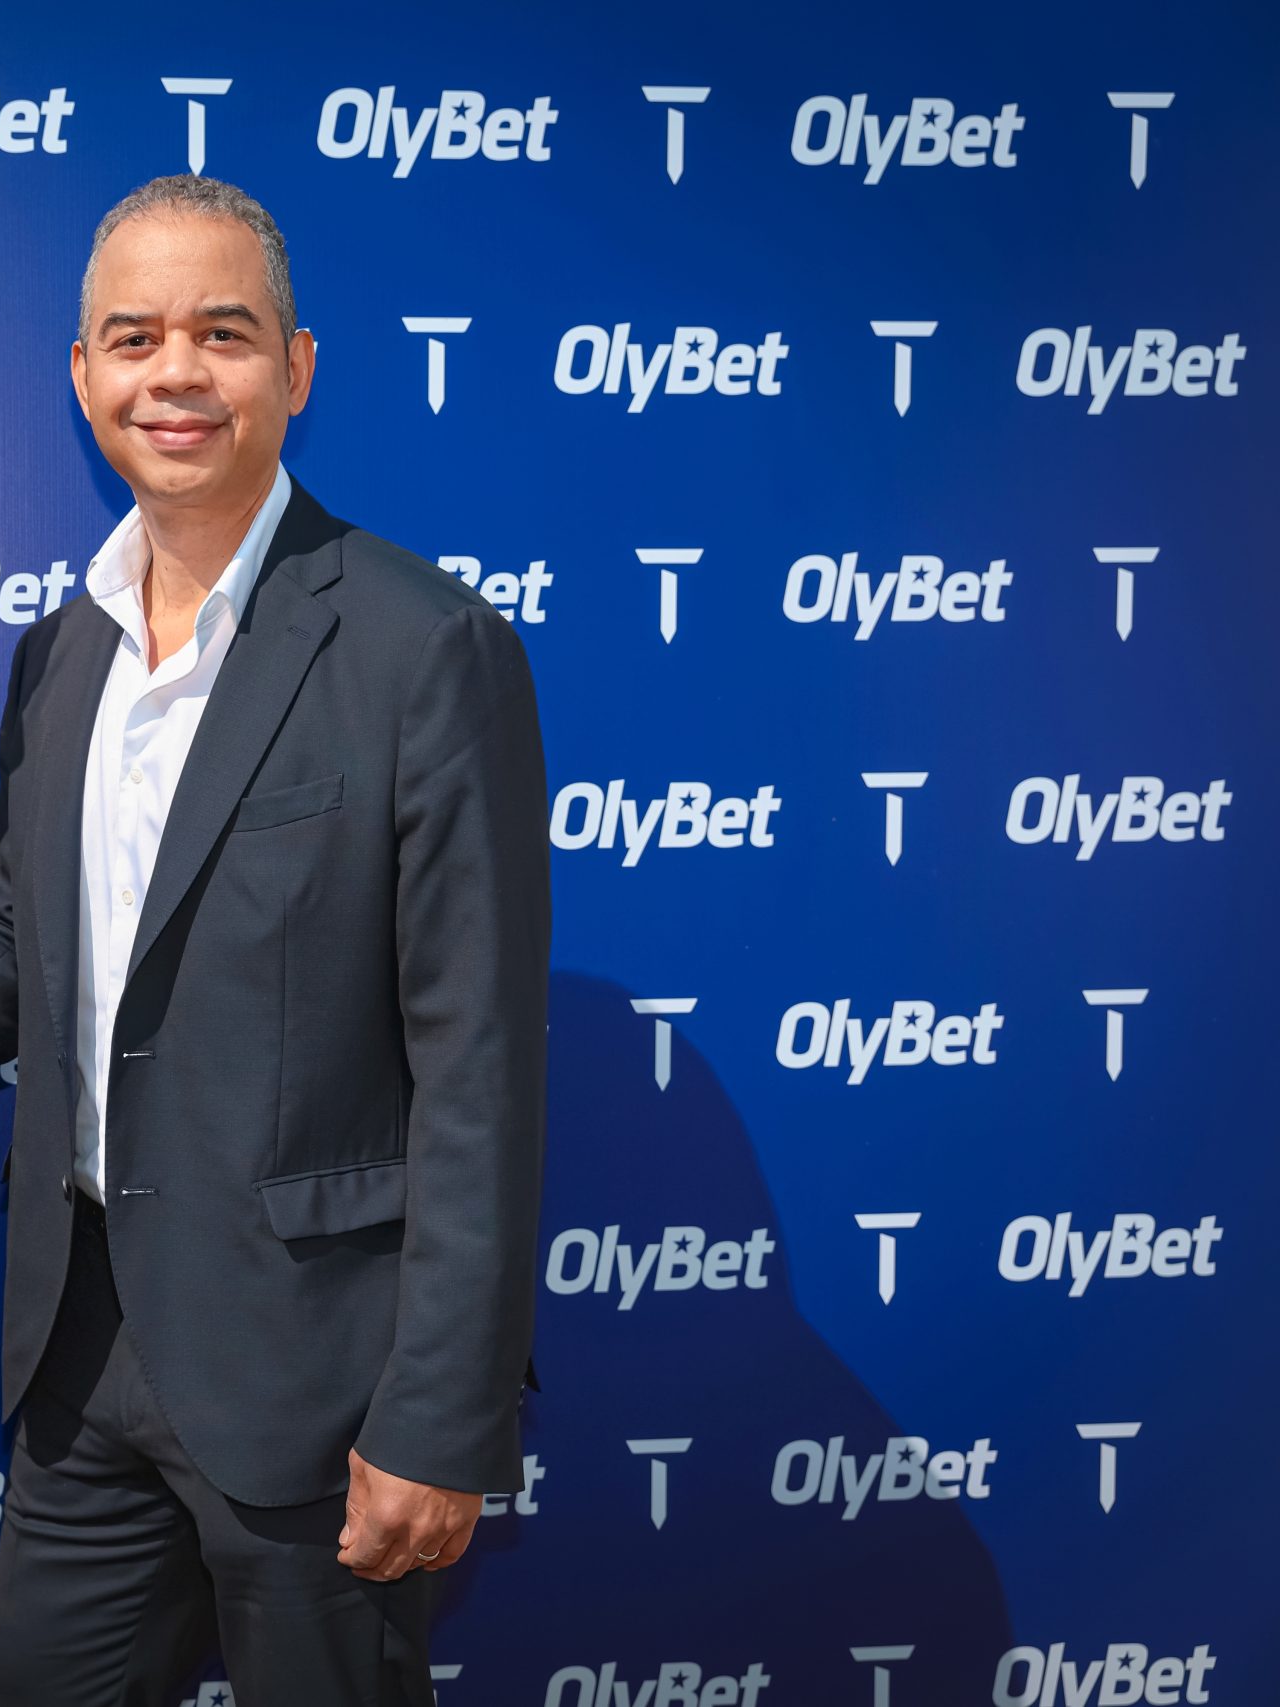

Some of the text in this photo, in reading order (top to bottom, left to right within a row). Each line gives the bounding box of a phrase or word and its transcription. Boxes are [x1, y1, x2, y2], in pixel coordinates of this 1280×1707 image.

[317, 86, 559, 178] OlyBet
[791, 94, 1025, 184] OlyBet
[554, 323, 789, 413] OlyBet
[1016, 326, 1246, 415] OlyBet
[783, 552, 1013, 640] OlyBet
[549, 779, 782, 867] OlyBet
[1006, 774, 1232, 861] OlyBet
[776, 999, 1004, 1085] OlyBet
[546, 1225, 775, 1310] OlyBet
[998, 1212, 1223, 1297] OlyBet
[771, 1436, 997, 1519] OlyBet
[992, 1642, 1217, 1707] OlyBet
